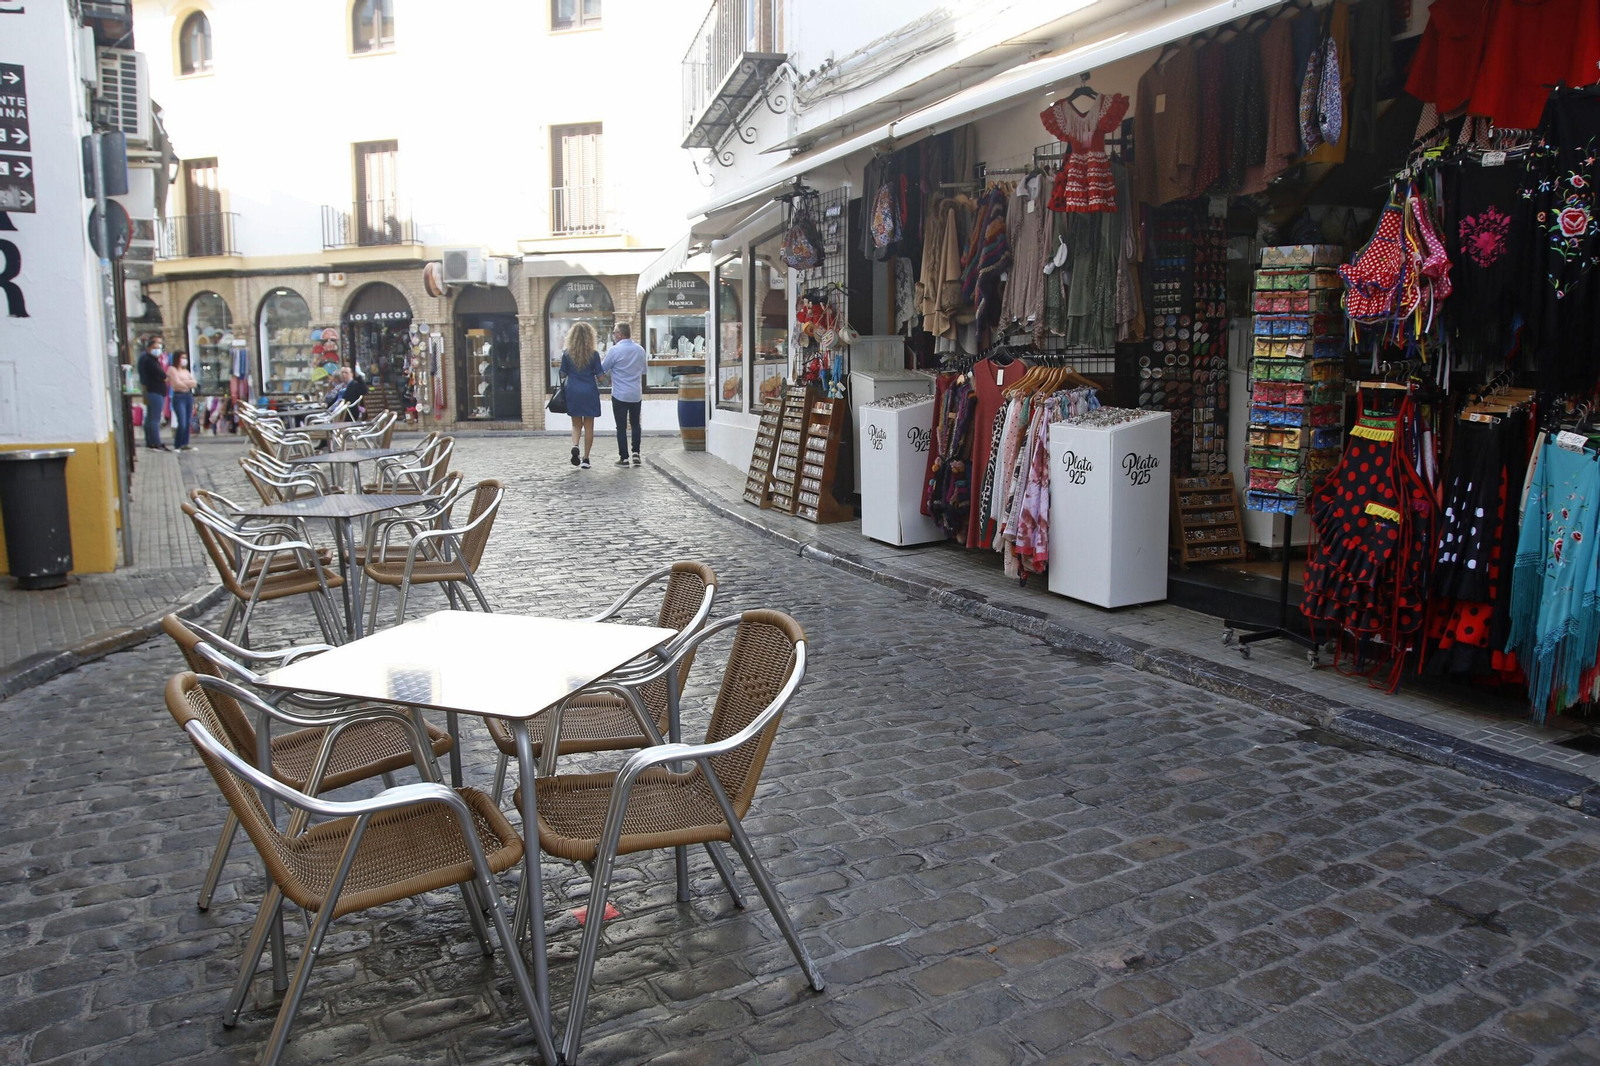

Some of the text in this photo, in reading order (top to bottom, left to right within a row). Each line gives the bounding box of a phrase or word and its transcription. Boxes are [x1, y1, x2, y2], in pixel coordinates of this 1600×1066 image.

[350, 311, 407, 321] LOS ARCOS
[868, 424, 887, 441] Plata
[907, 426, 932, 445] Plat
[872, 438, 883, 450] 925
[1062, 450, 1094, 472] Plata
[1122, 452, 1160, 476] Plata
[1069, 469, 1086, 485] 925
[1131, 469, 1151, 486] 925
